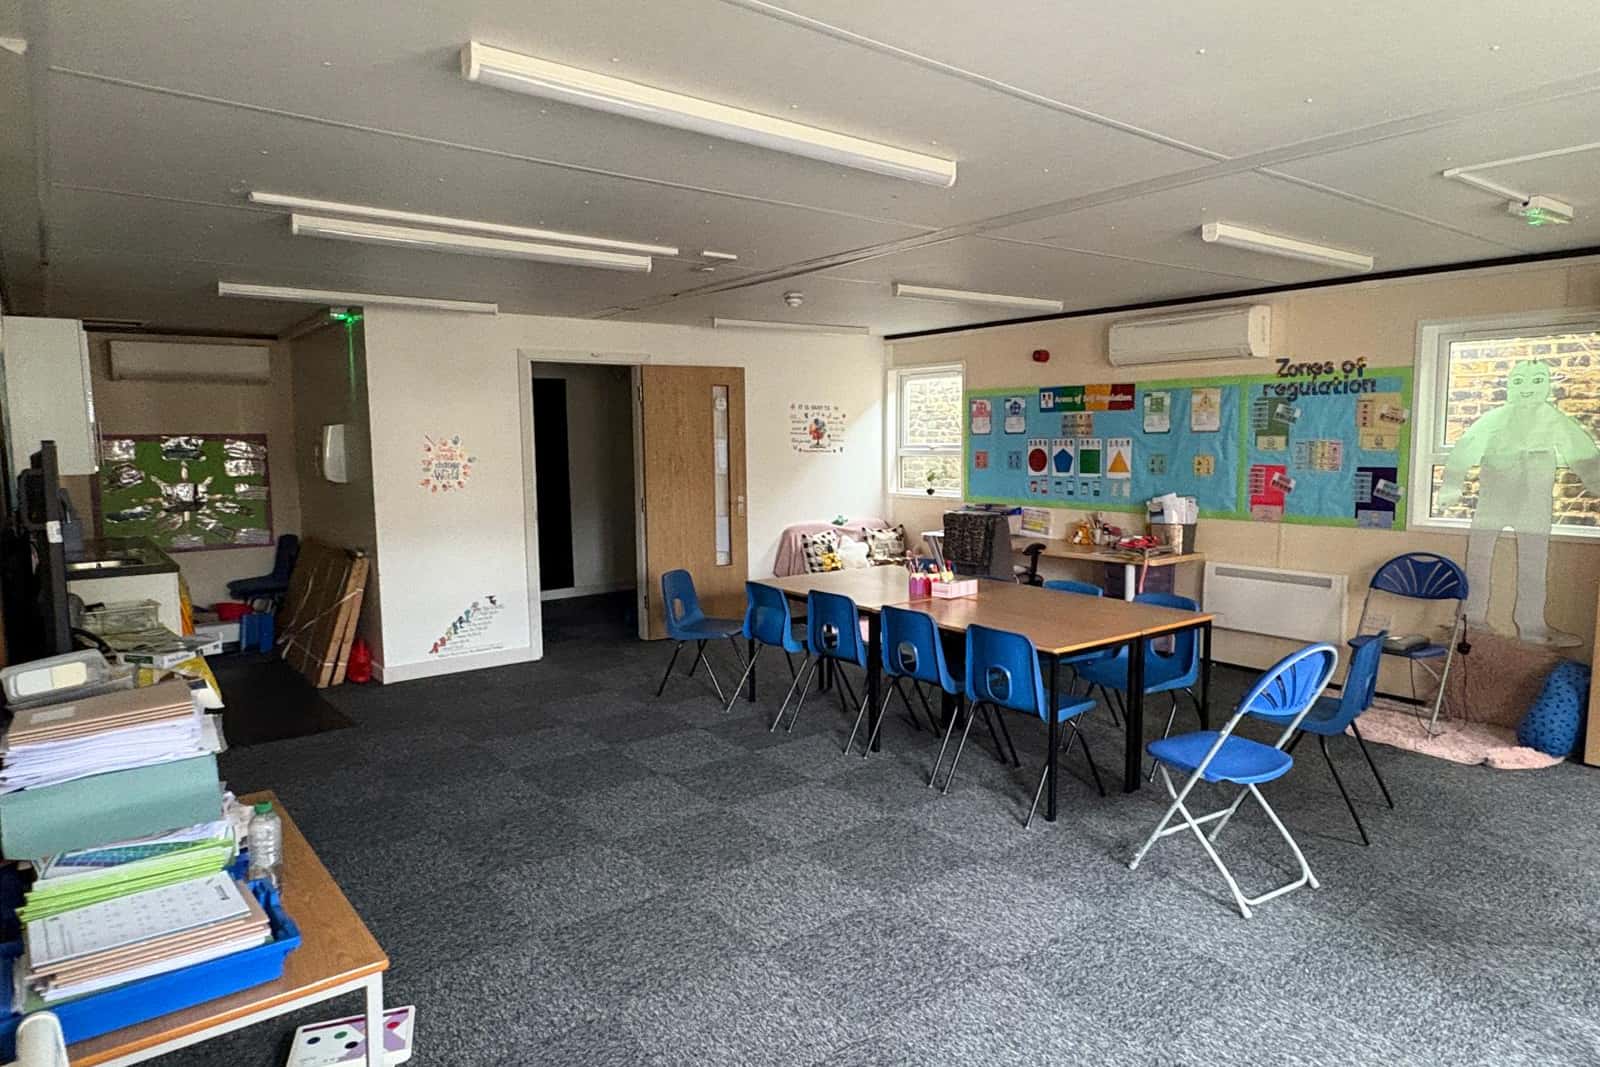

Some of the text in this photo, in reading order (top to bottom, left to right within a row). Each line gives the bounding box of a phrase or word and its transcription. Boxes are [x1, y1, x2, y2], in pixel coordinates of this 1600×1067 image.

[1275, 356, 1367, 378] Zones of
[1263, 375, 1376, 402] regulation
